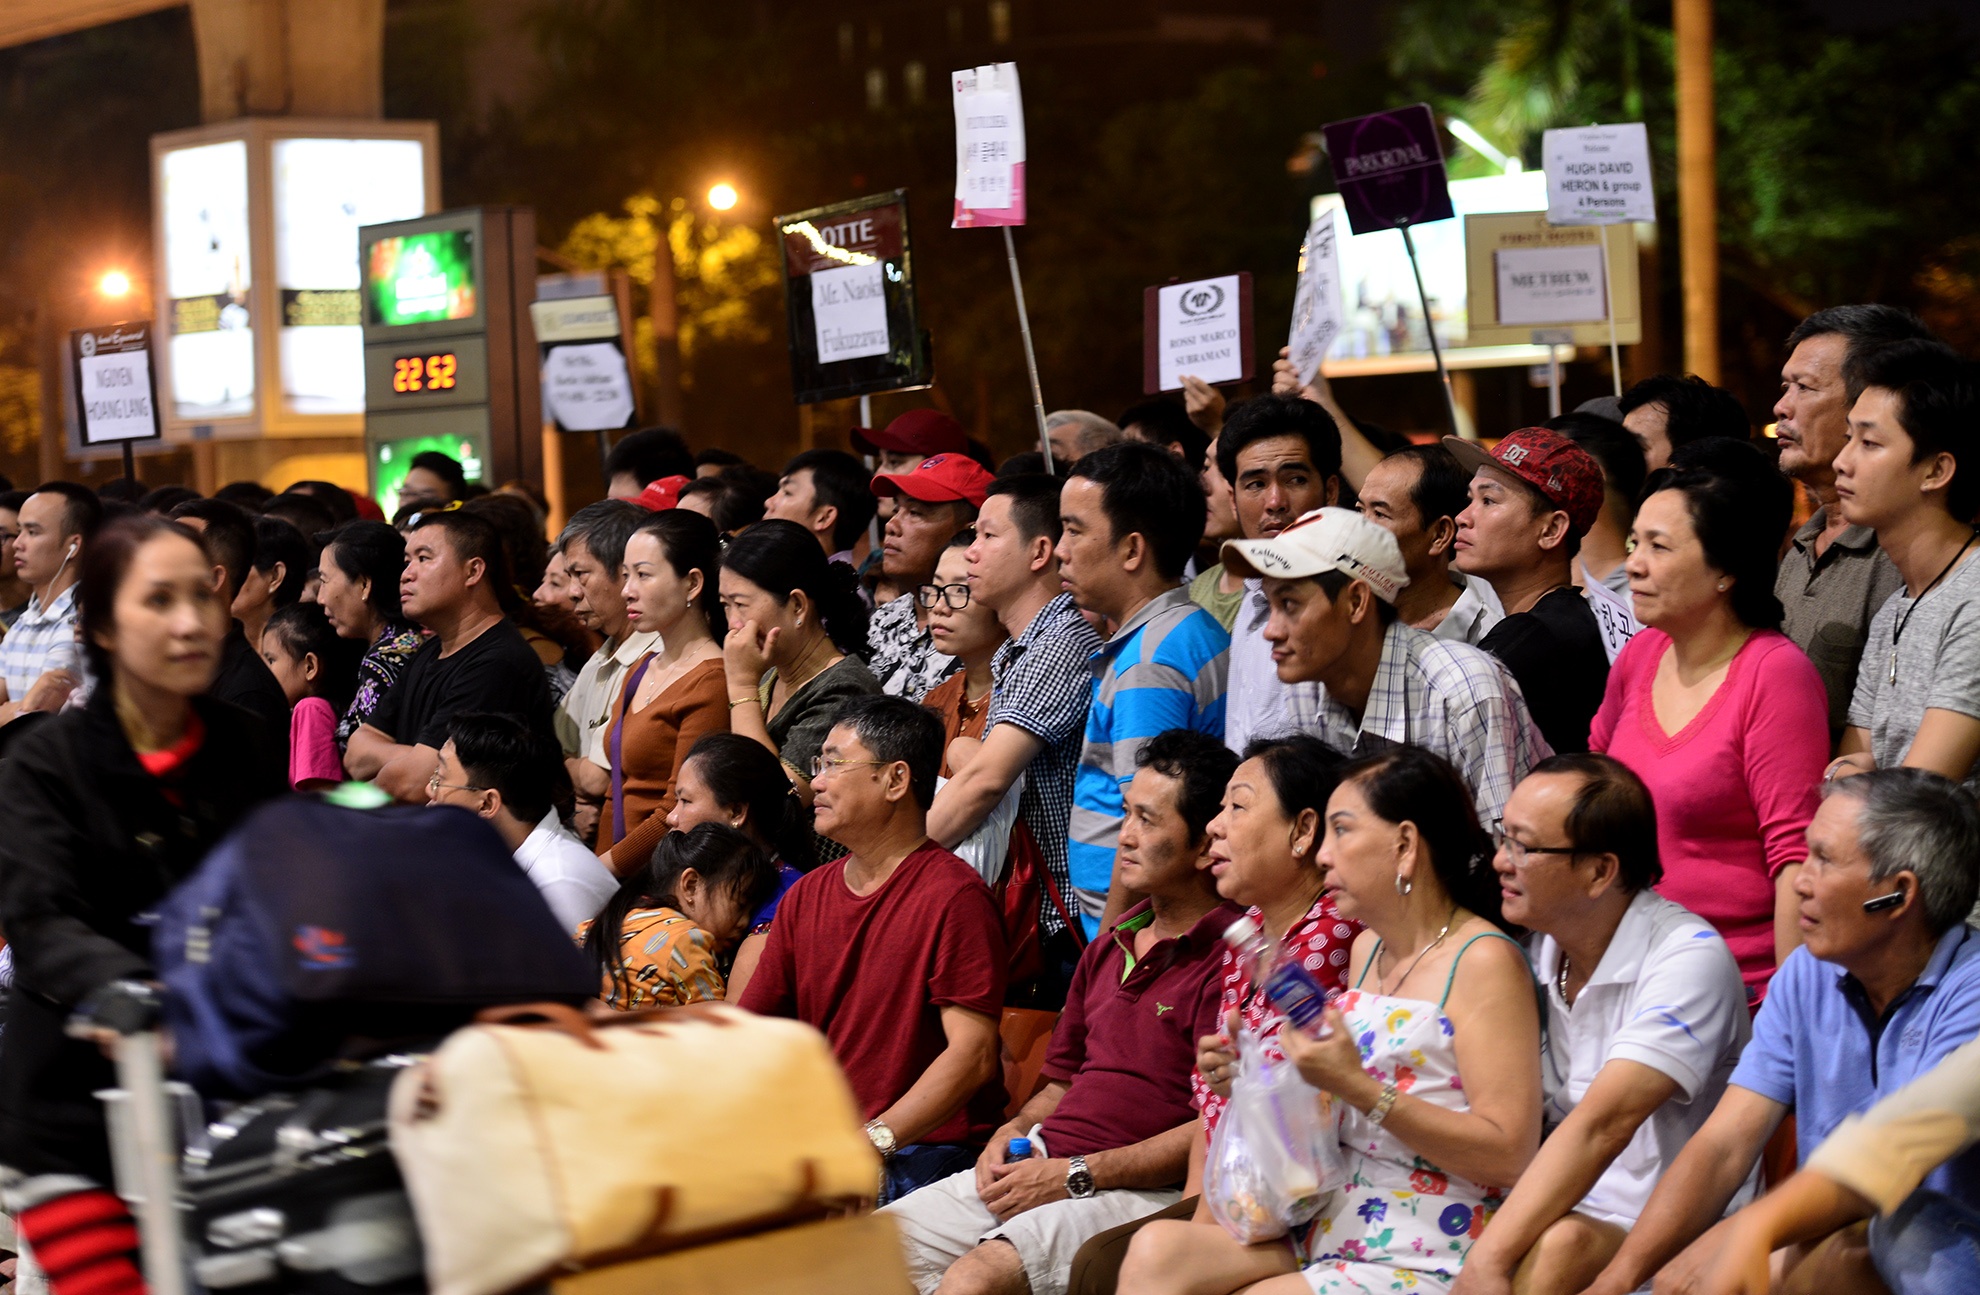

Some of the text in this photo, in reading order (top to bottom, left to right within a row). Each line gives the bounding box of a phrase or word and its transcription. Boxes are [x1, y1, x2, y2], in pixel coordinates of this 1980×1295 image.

[1565, 162, 1634, 175] HUGH DAVID
[1561, 180, 1642, 195] HERON & group
[1586, 196, 1626, 208] Persons
[811, 217, 875, 251] OTTE
[821, 327, 887, 354] Fukuzawa
[1169, 328, 1237, 349] ROSSI MARCO
[1174, 347, 1231, 367] SUBRAMANI
[96, 366, 134, 389] NGUYEN
[86, 396, 150, 421] HOANG LANG
